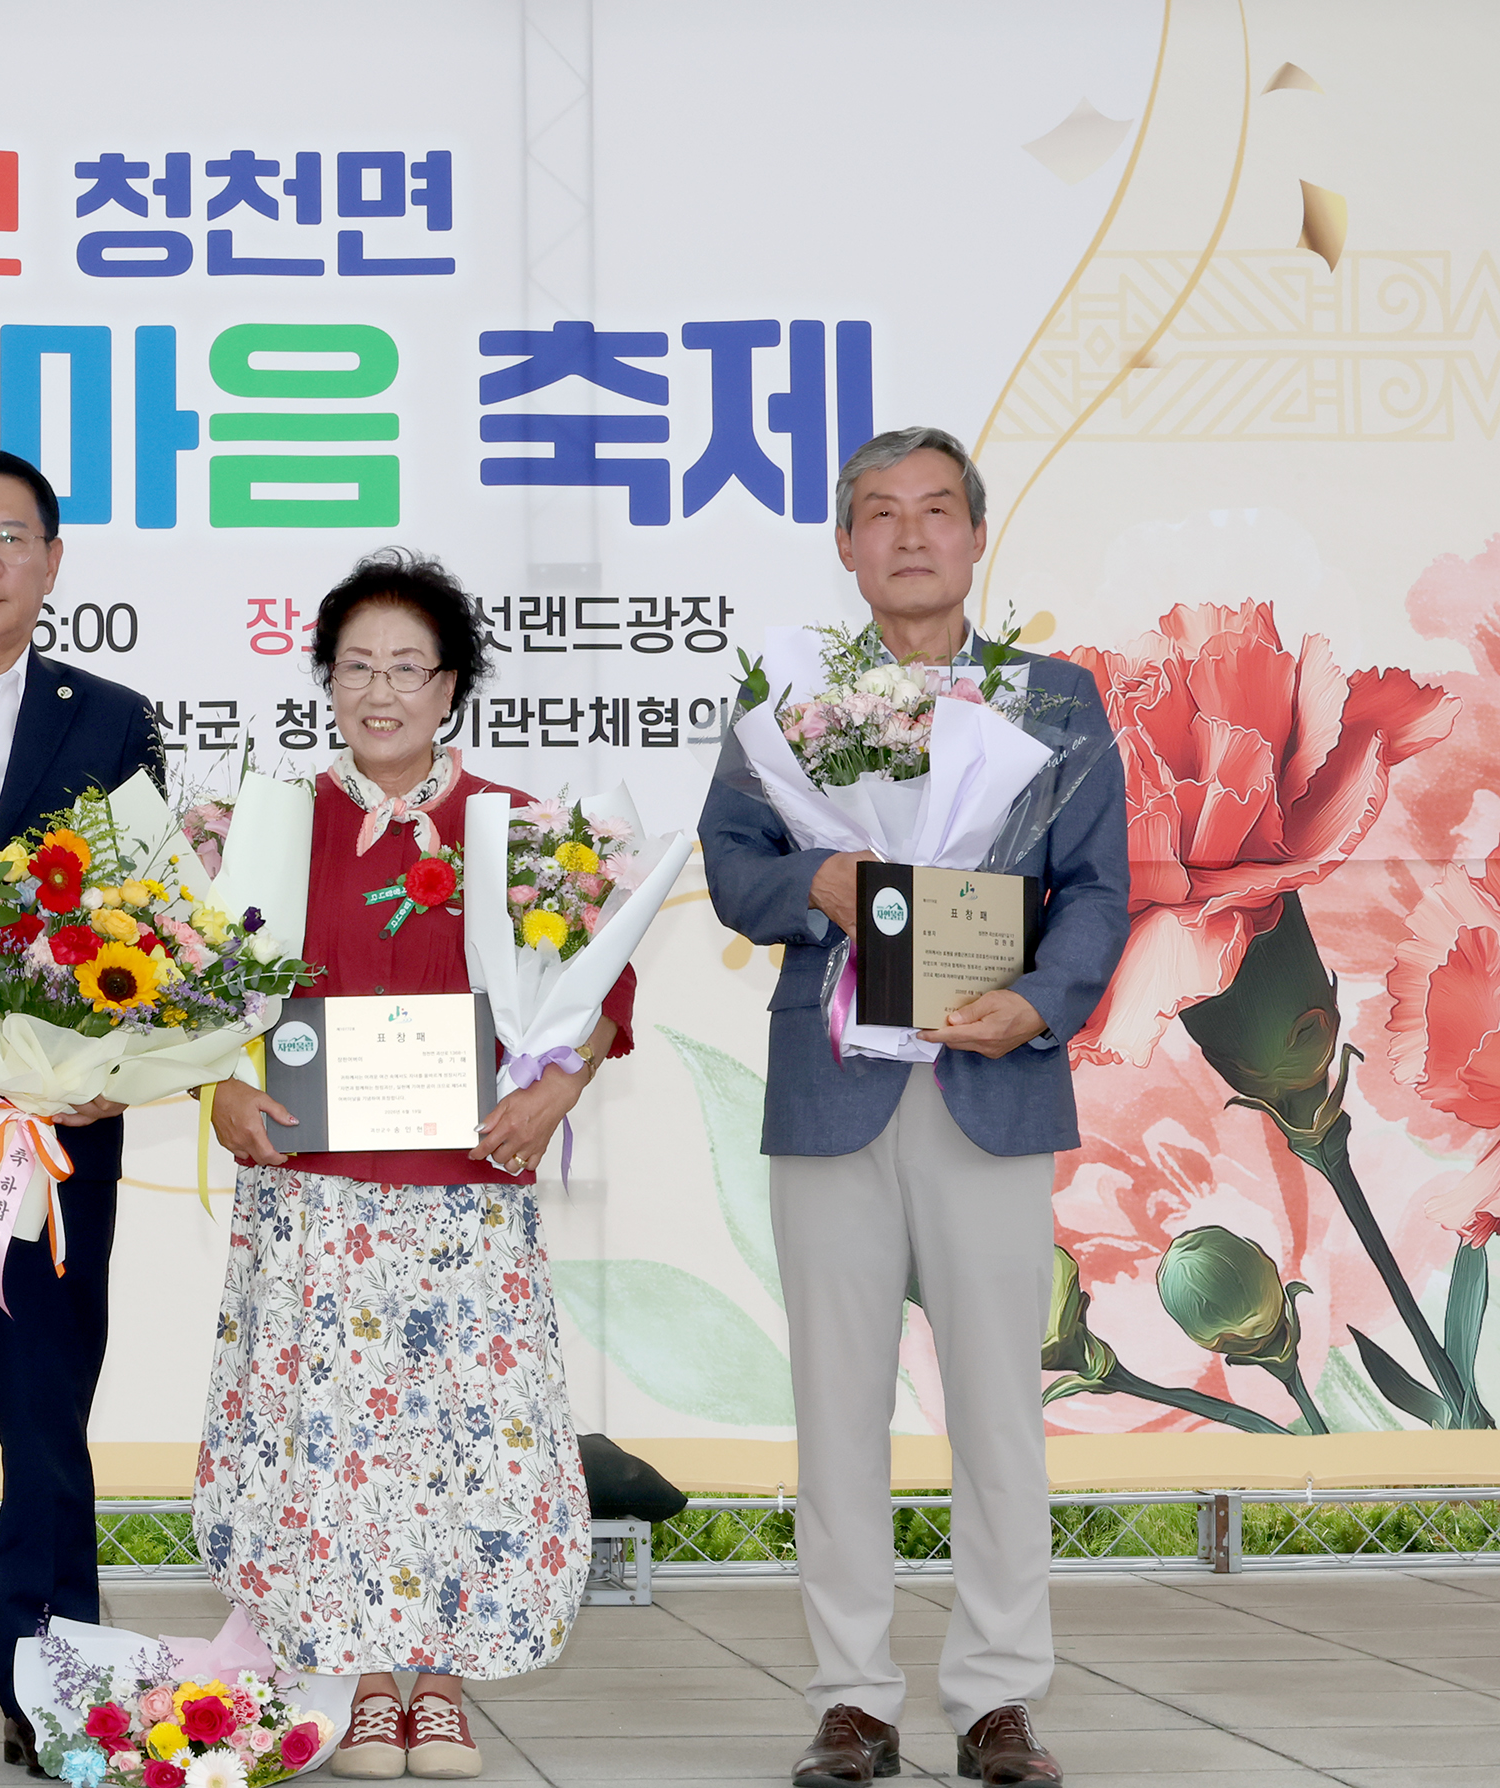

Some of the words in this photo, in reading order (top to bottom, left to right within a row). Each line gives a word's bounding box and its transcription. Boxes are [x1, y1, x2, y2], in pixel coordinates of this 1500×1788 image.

[75, 151, 455, 277] 청천면
[479, 319, 873, 527] 축제
[475, 595, 735, 654] 섯랜드광장
